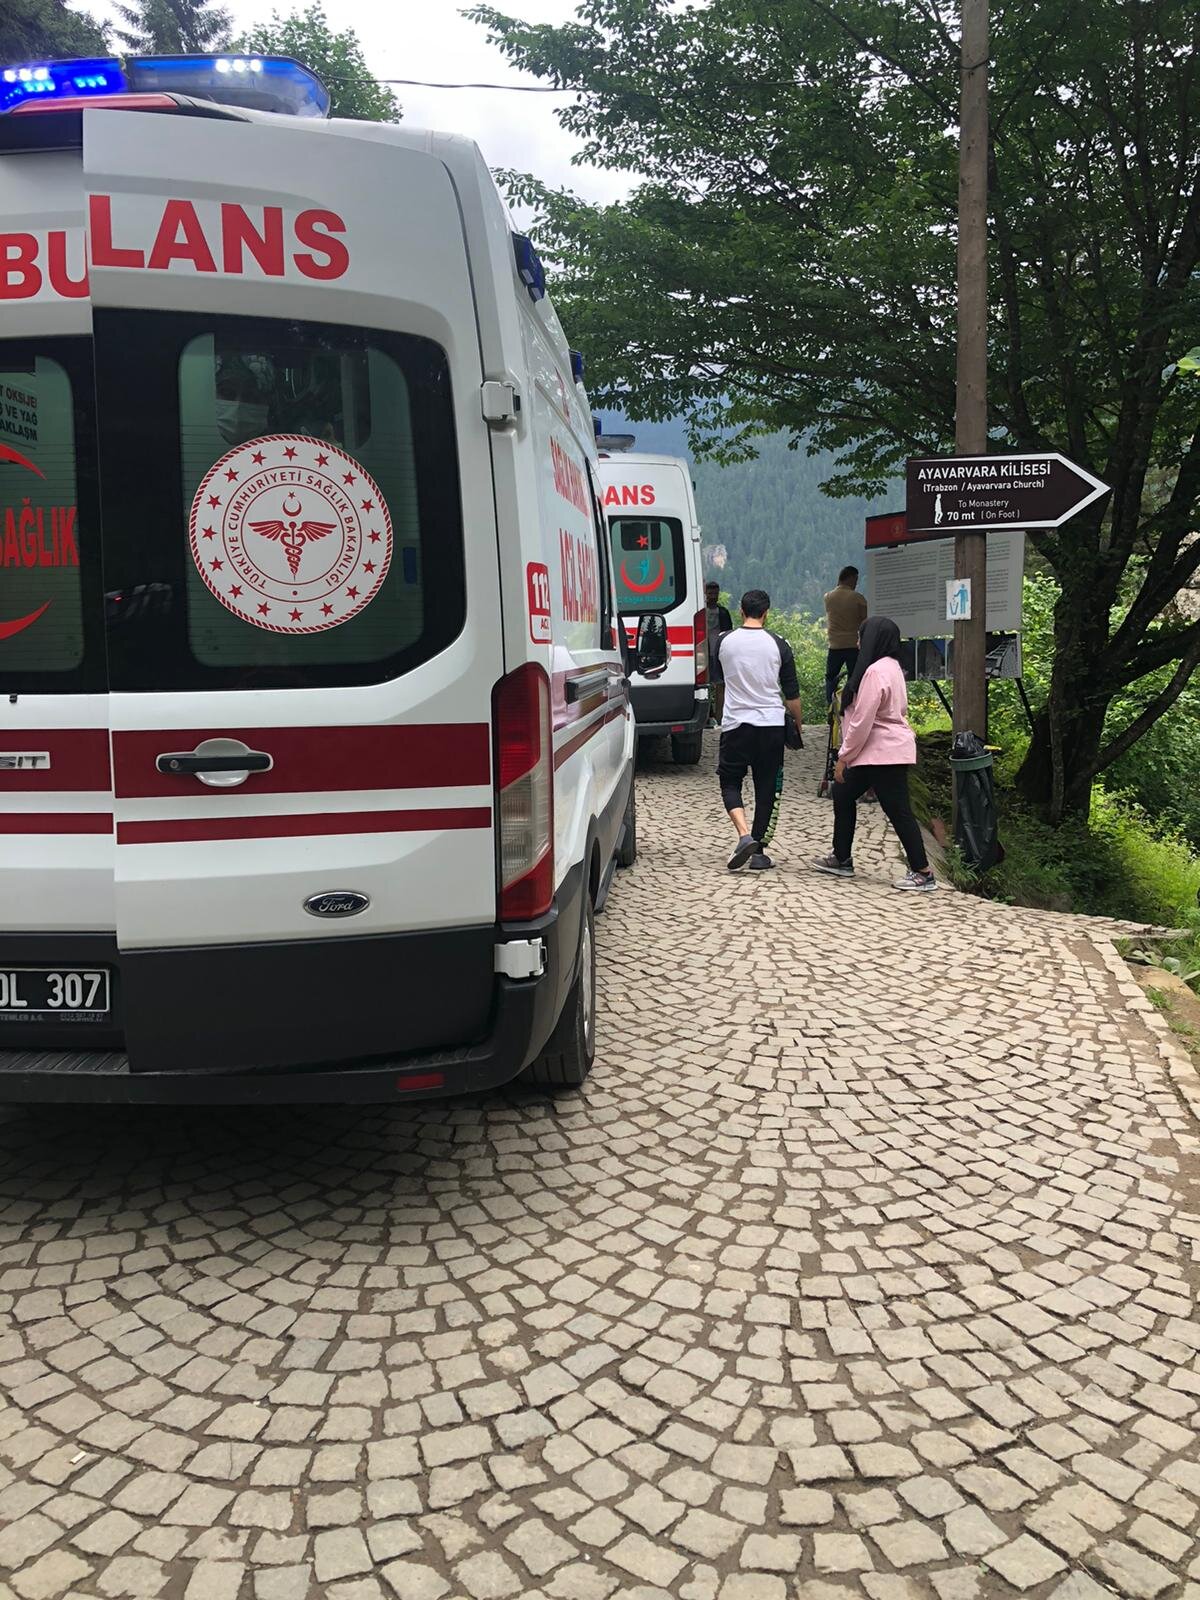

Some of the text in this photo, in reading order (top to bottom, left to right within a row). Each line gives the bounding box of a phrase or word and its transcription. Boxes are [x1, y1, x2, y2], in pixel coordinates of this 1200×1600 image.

[918, 461, 1050, 480] AYAVARVARA KİLİSESİ
[966, 481, 1011, 492] Ayavarvara
[1013, 479, 1045, 489] Church)
[958, 499, 1009, 509] To Monastery
[947, 511, 959, 521] 70
[961, 511, 975, 521] mt
[0, 497, 80, 568] AĞLIK
[228, 470, 357, 589] TÜRKİYE CUMHURİYETİ SAĞLIK BAKANLIĞI
[318, 896, 354, 912] Ford
[46, 972, 102, 1008] 307
